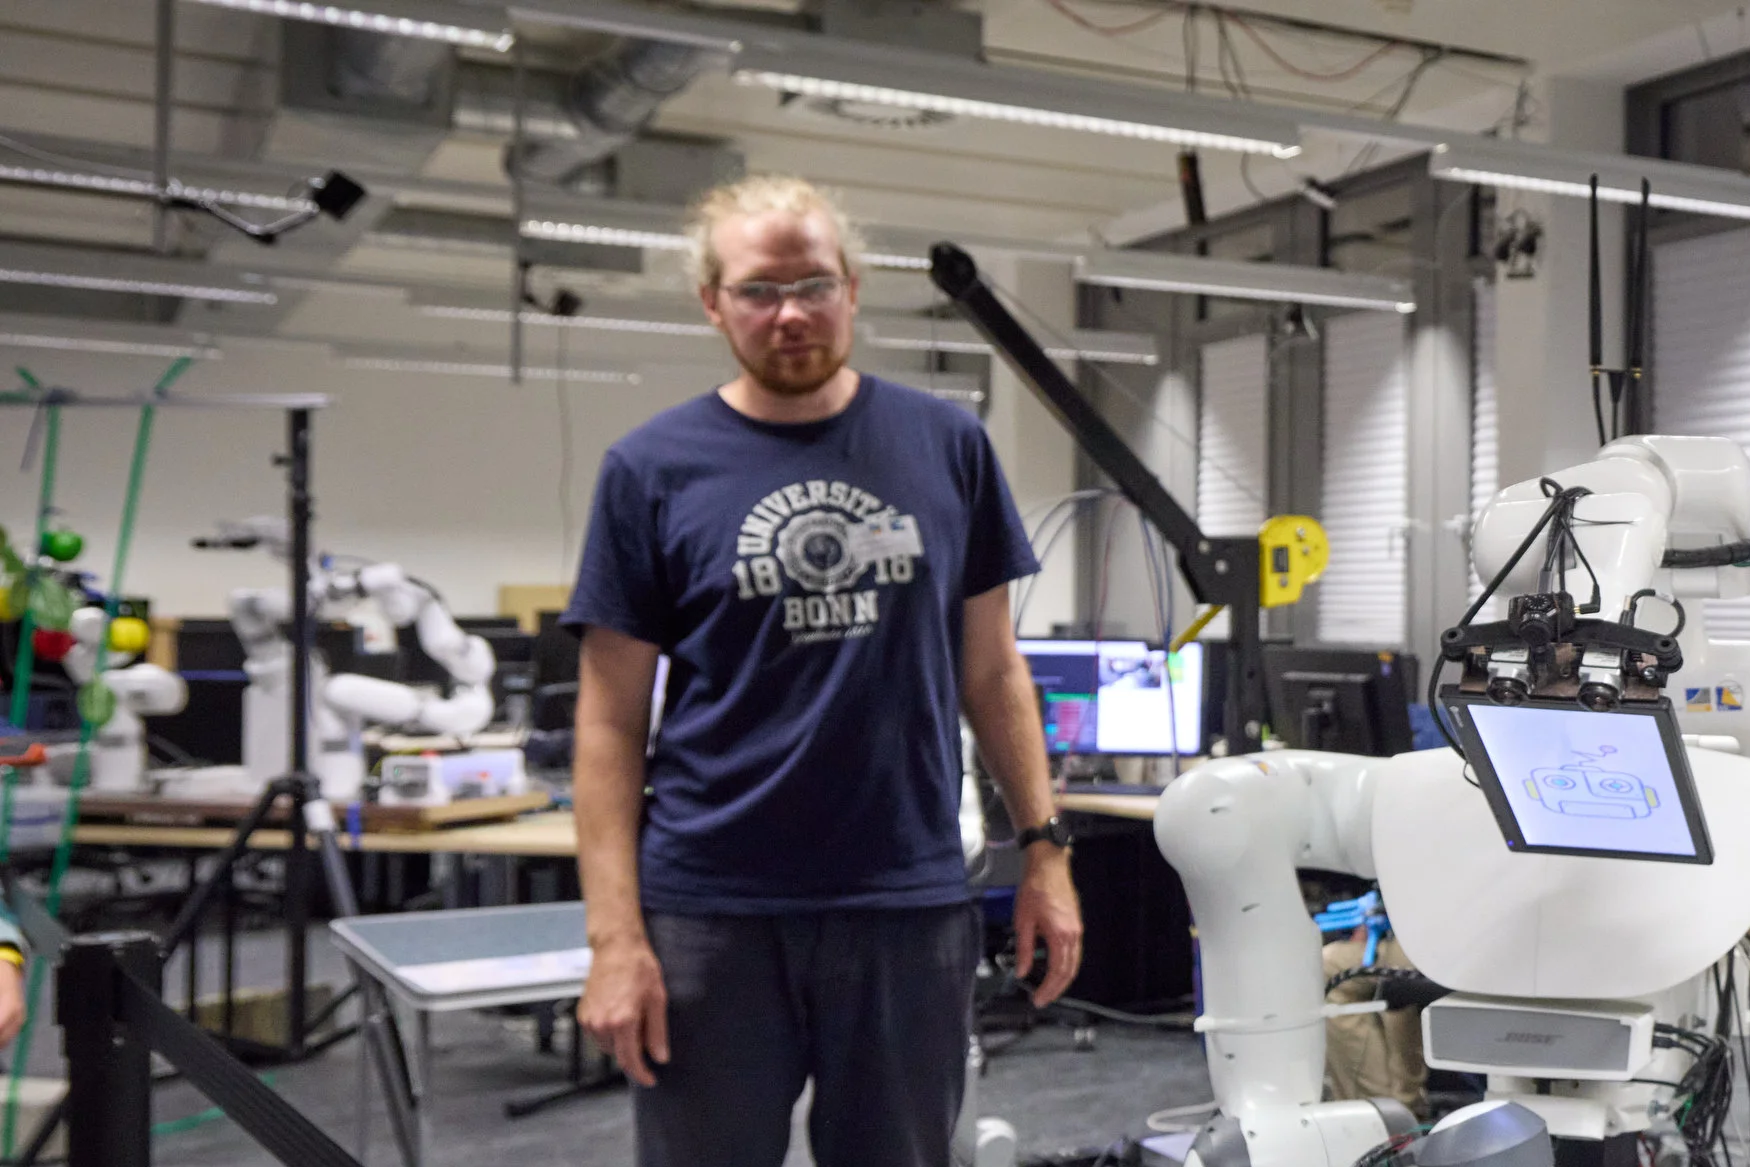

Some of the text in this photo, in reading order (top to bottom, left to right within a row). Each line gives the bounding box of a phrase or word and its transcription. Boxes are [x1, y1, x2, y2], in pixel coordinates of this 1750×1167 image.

[737, 480, 898, 556] UNIVERSIT
[731, 555, 783, 600] 18
[783, 590, 878, 631] BONN
